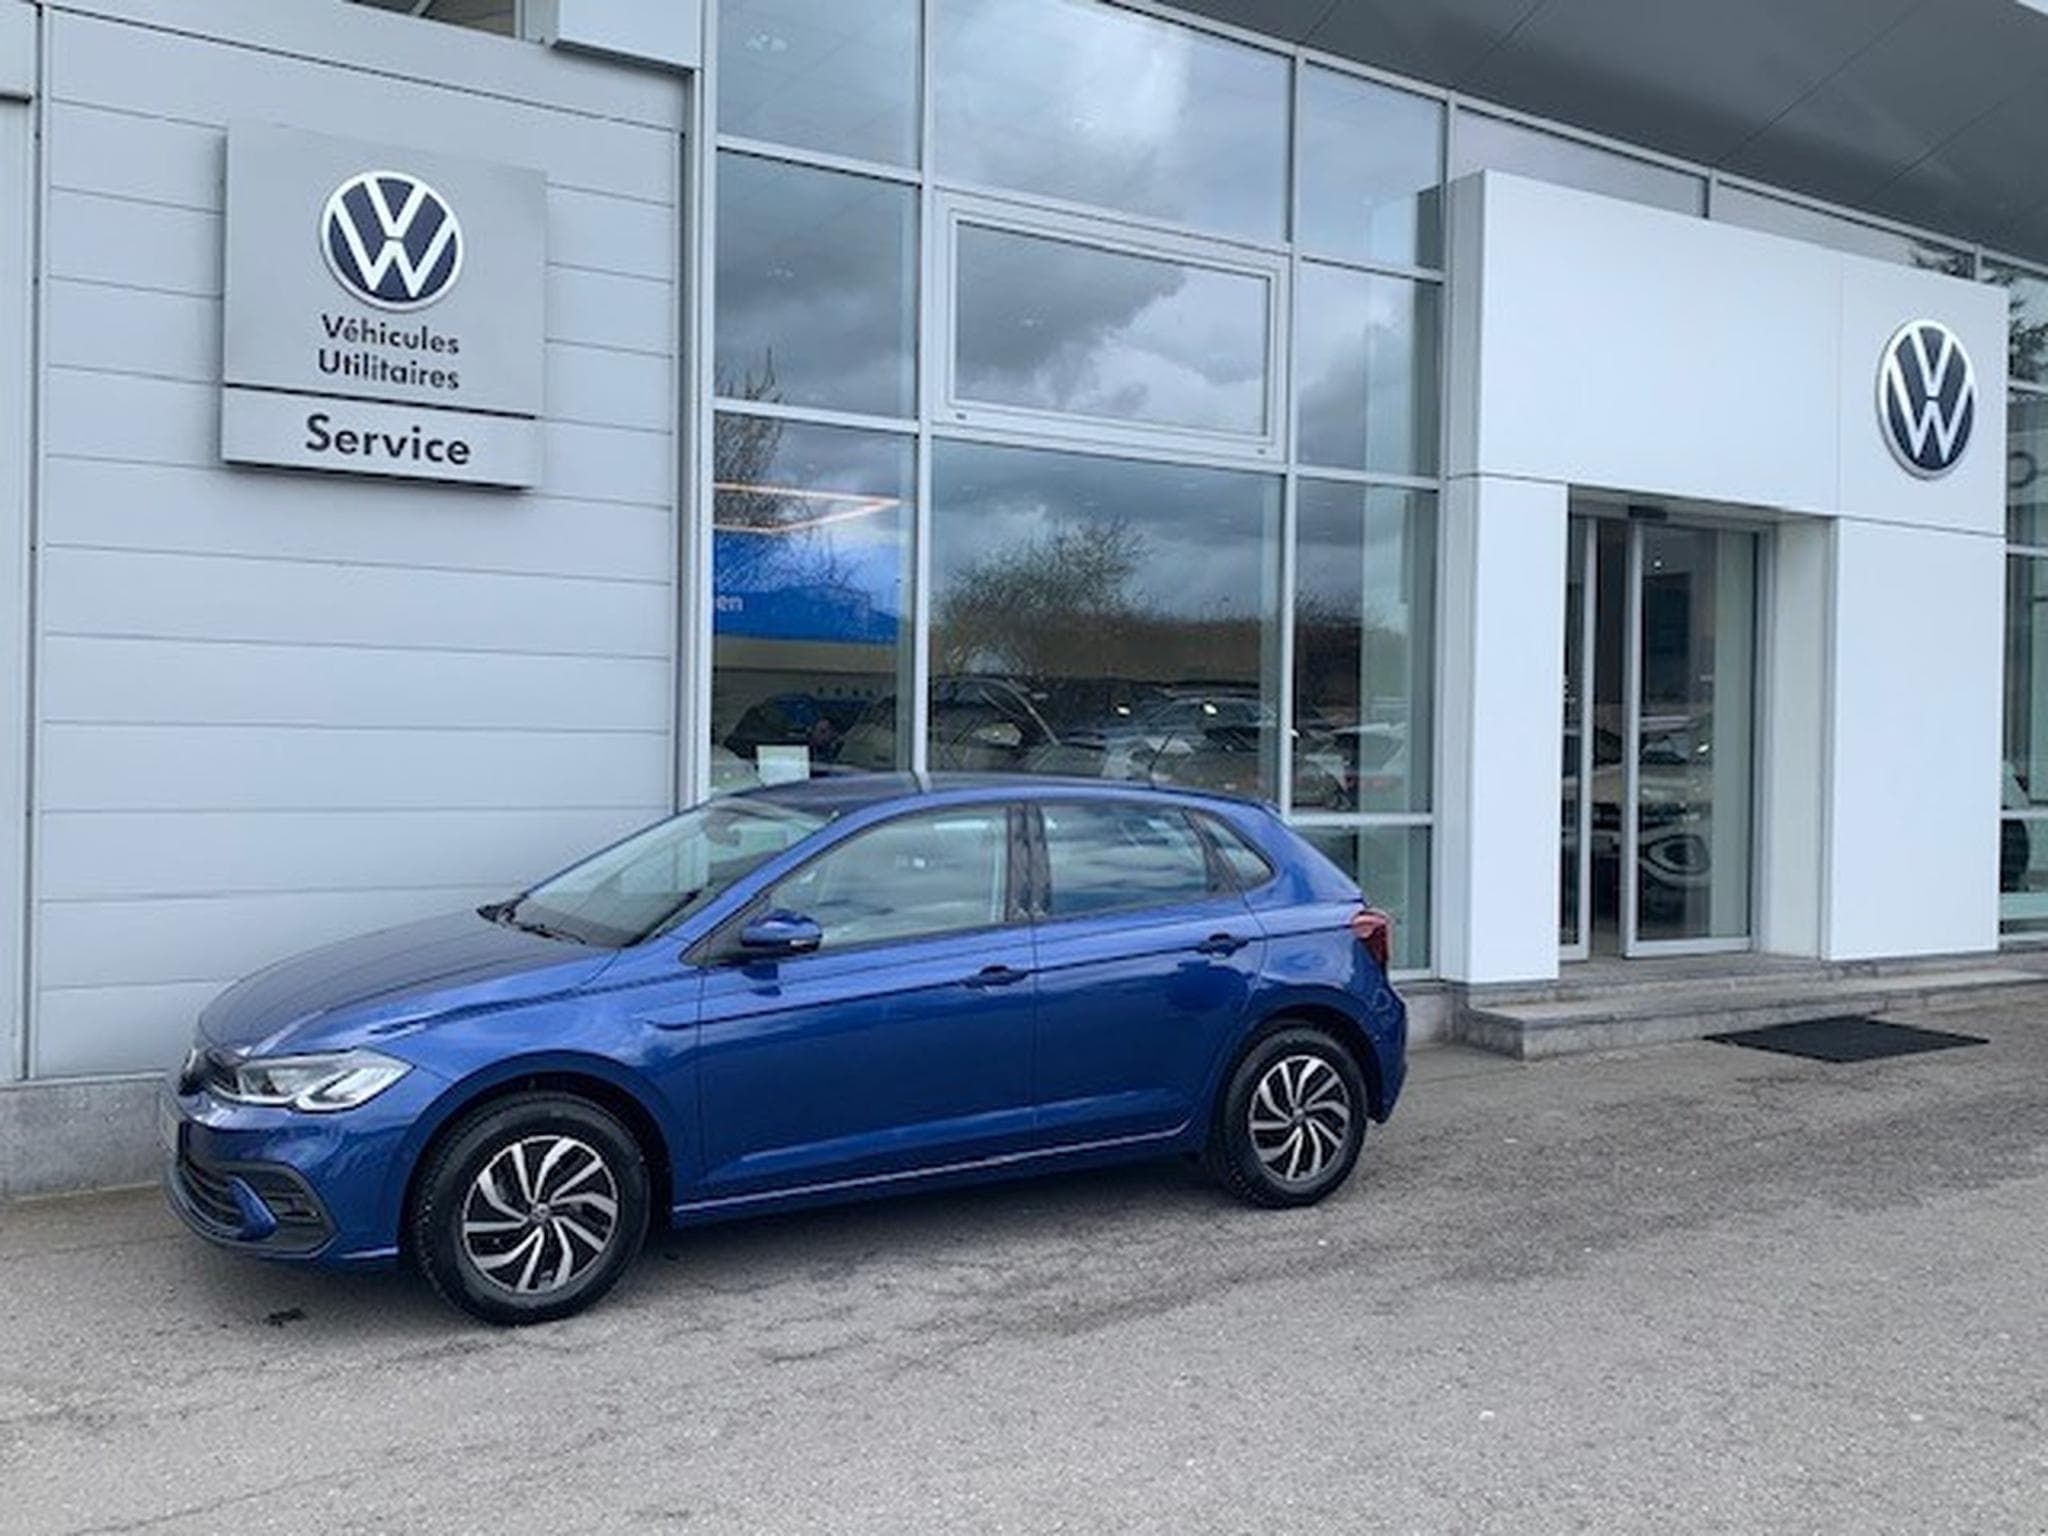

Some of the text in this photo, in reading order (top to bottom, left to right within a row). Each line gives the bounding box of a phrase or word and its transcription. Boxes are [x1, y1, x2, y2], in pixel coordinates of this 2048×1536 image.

[321, 171, 463, 308] VW
[321, 313, 460, 354] Véhicules
[319, 349, 460, 390] Utilitaires
[1878, 320, 1978, 475] VW
[305, 413, 471, 465] Service
